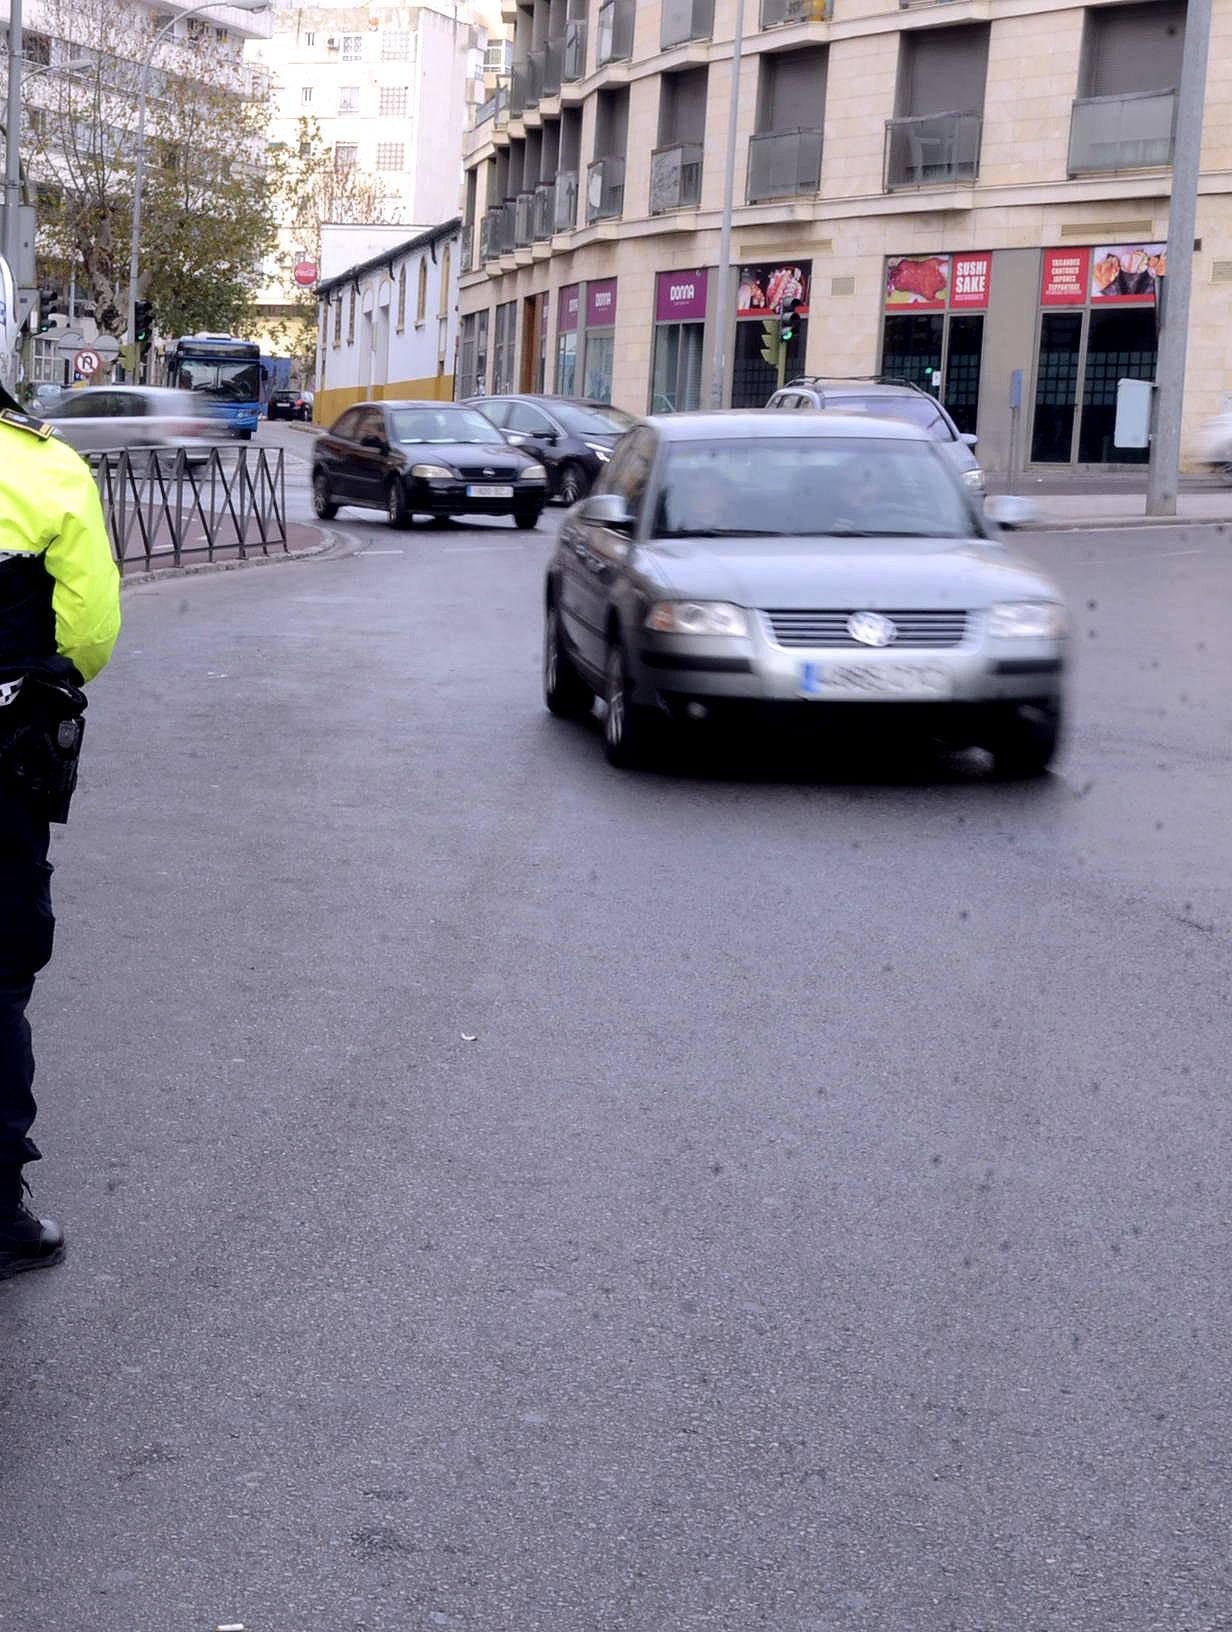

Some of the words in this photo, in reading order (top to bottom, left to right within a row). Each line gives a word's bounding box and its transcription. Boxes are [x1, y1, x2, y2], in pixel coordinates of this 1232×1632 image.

[956, 260, 987, 276] SUSHI
[670, 284, 694, 301] DONNA
[955, 276, 986, 293] SAKE
[595, 292, 612, 307] DONNA
